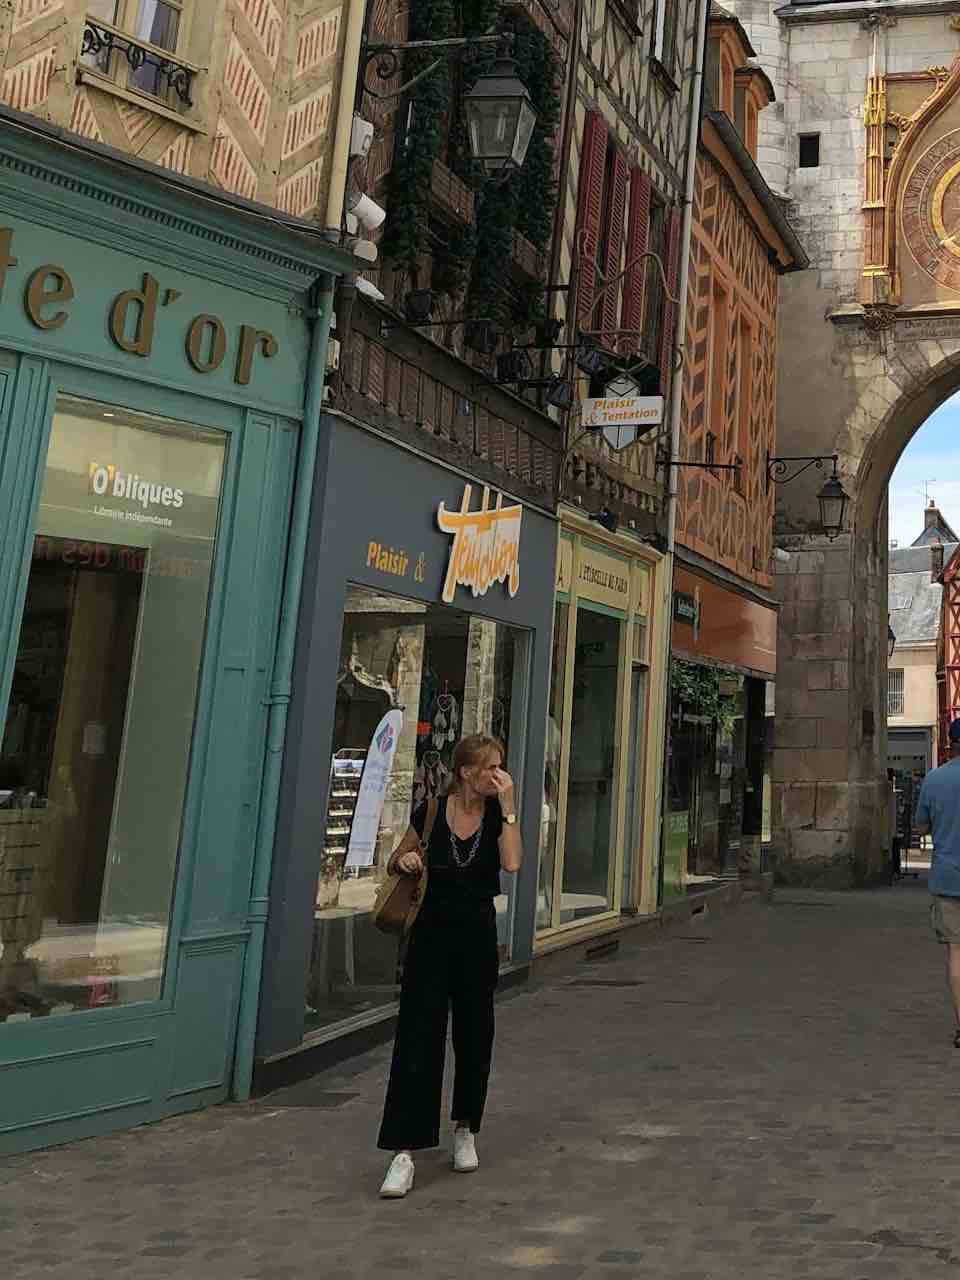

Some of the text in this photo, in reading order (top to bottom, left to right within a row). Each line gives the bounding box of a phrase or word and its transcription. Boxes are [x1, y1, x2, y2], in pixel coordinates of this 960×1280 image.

[108, 272, 279, 385] d'or
[601, 407, 658, 422] Tentation
[366, 542, 409, 577] Plaisir
[414, 551, 426, 583] &
